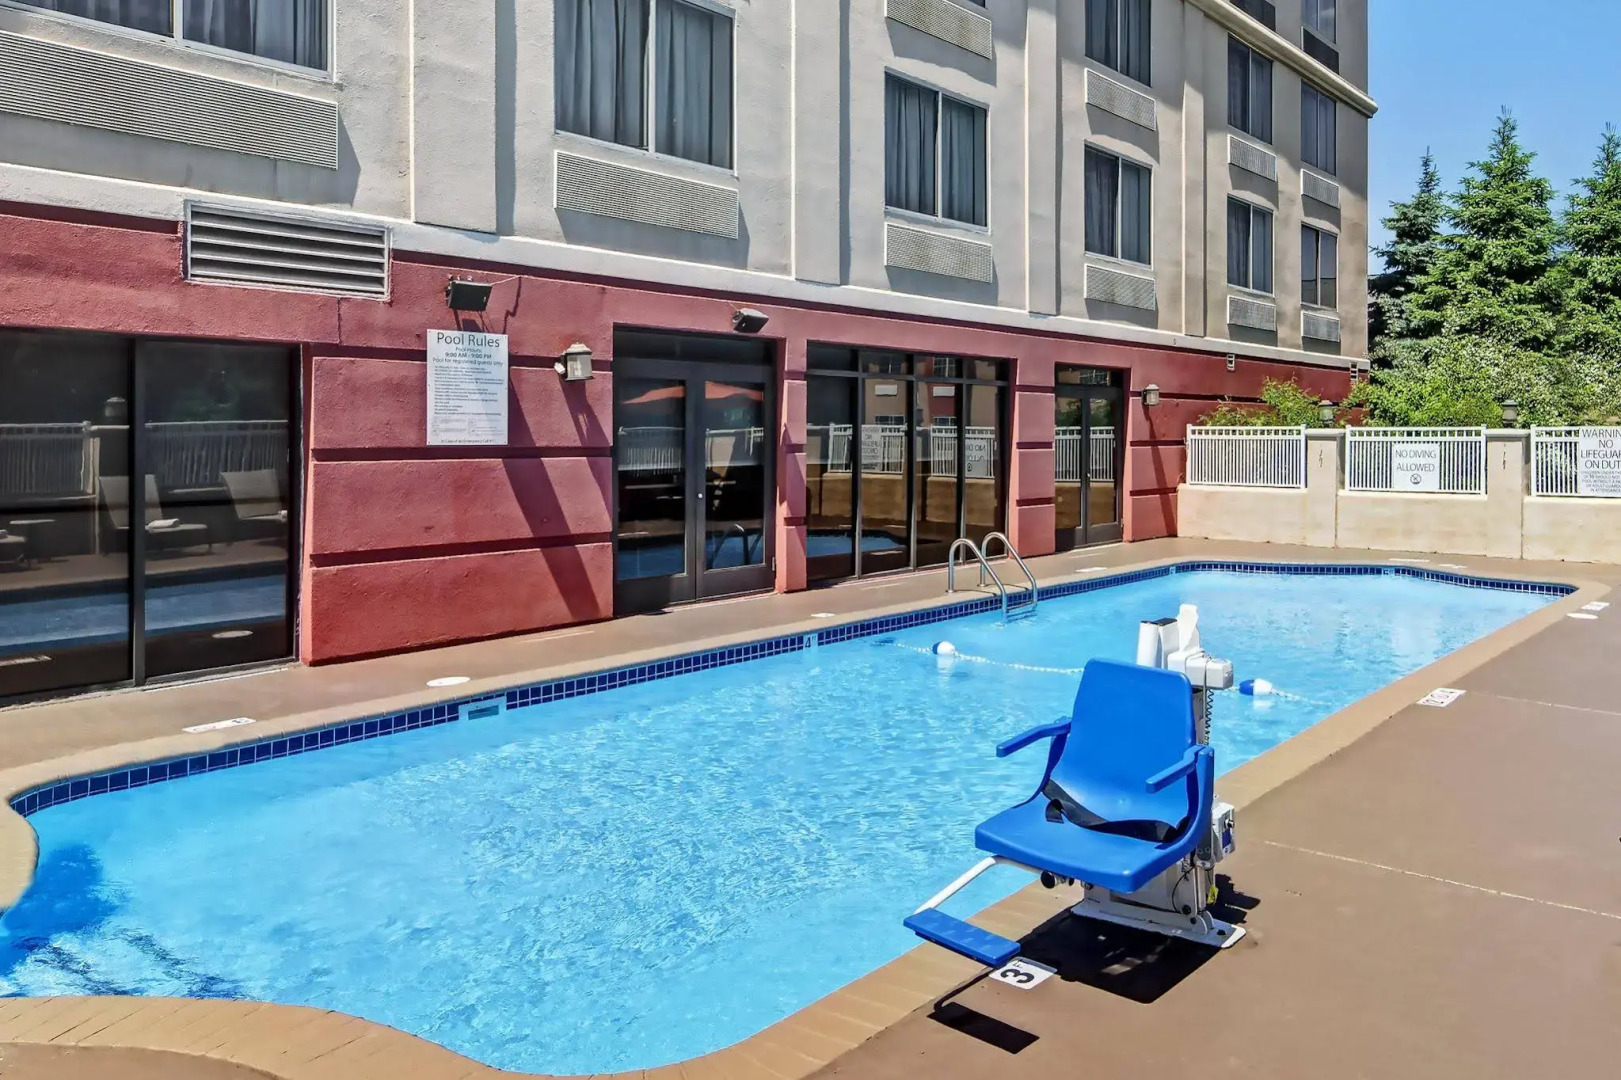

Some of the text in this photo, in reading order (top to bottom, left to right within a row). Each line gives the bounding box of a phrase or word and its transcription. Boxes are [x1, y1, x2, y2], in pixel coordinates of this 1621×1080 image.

[437, 332, 500, 348] Pool Rules
[1599, 439, 1614, 449] NO
[1396, 449, 1437, 459] NO DIVING
[1396, 462, 1436, 472] ALLOWED
[1585, 459, 1600, 469] ON
[805, 636, 811, 648] 4
[1000, 968, 1035, 983] 3
